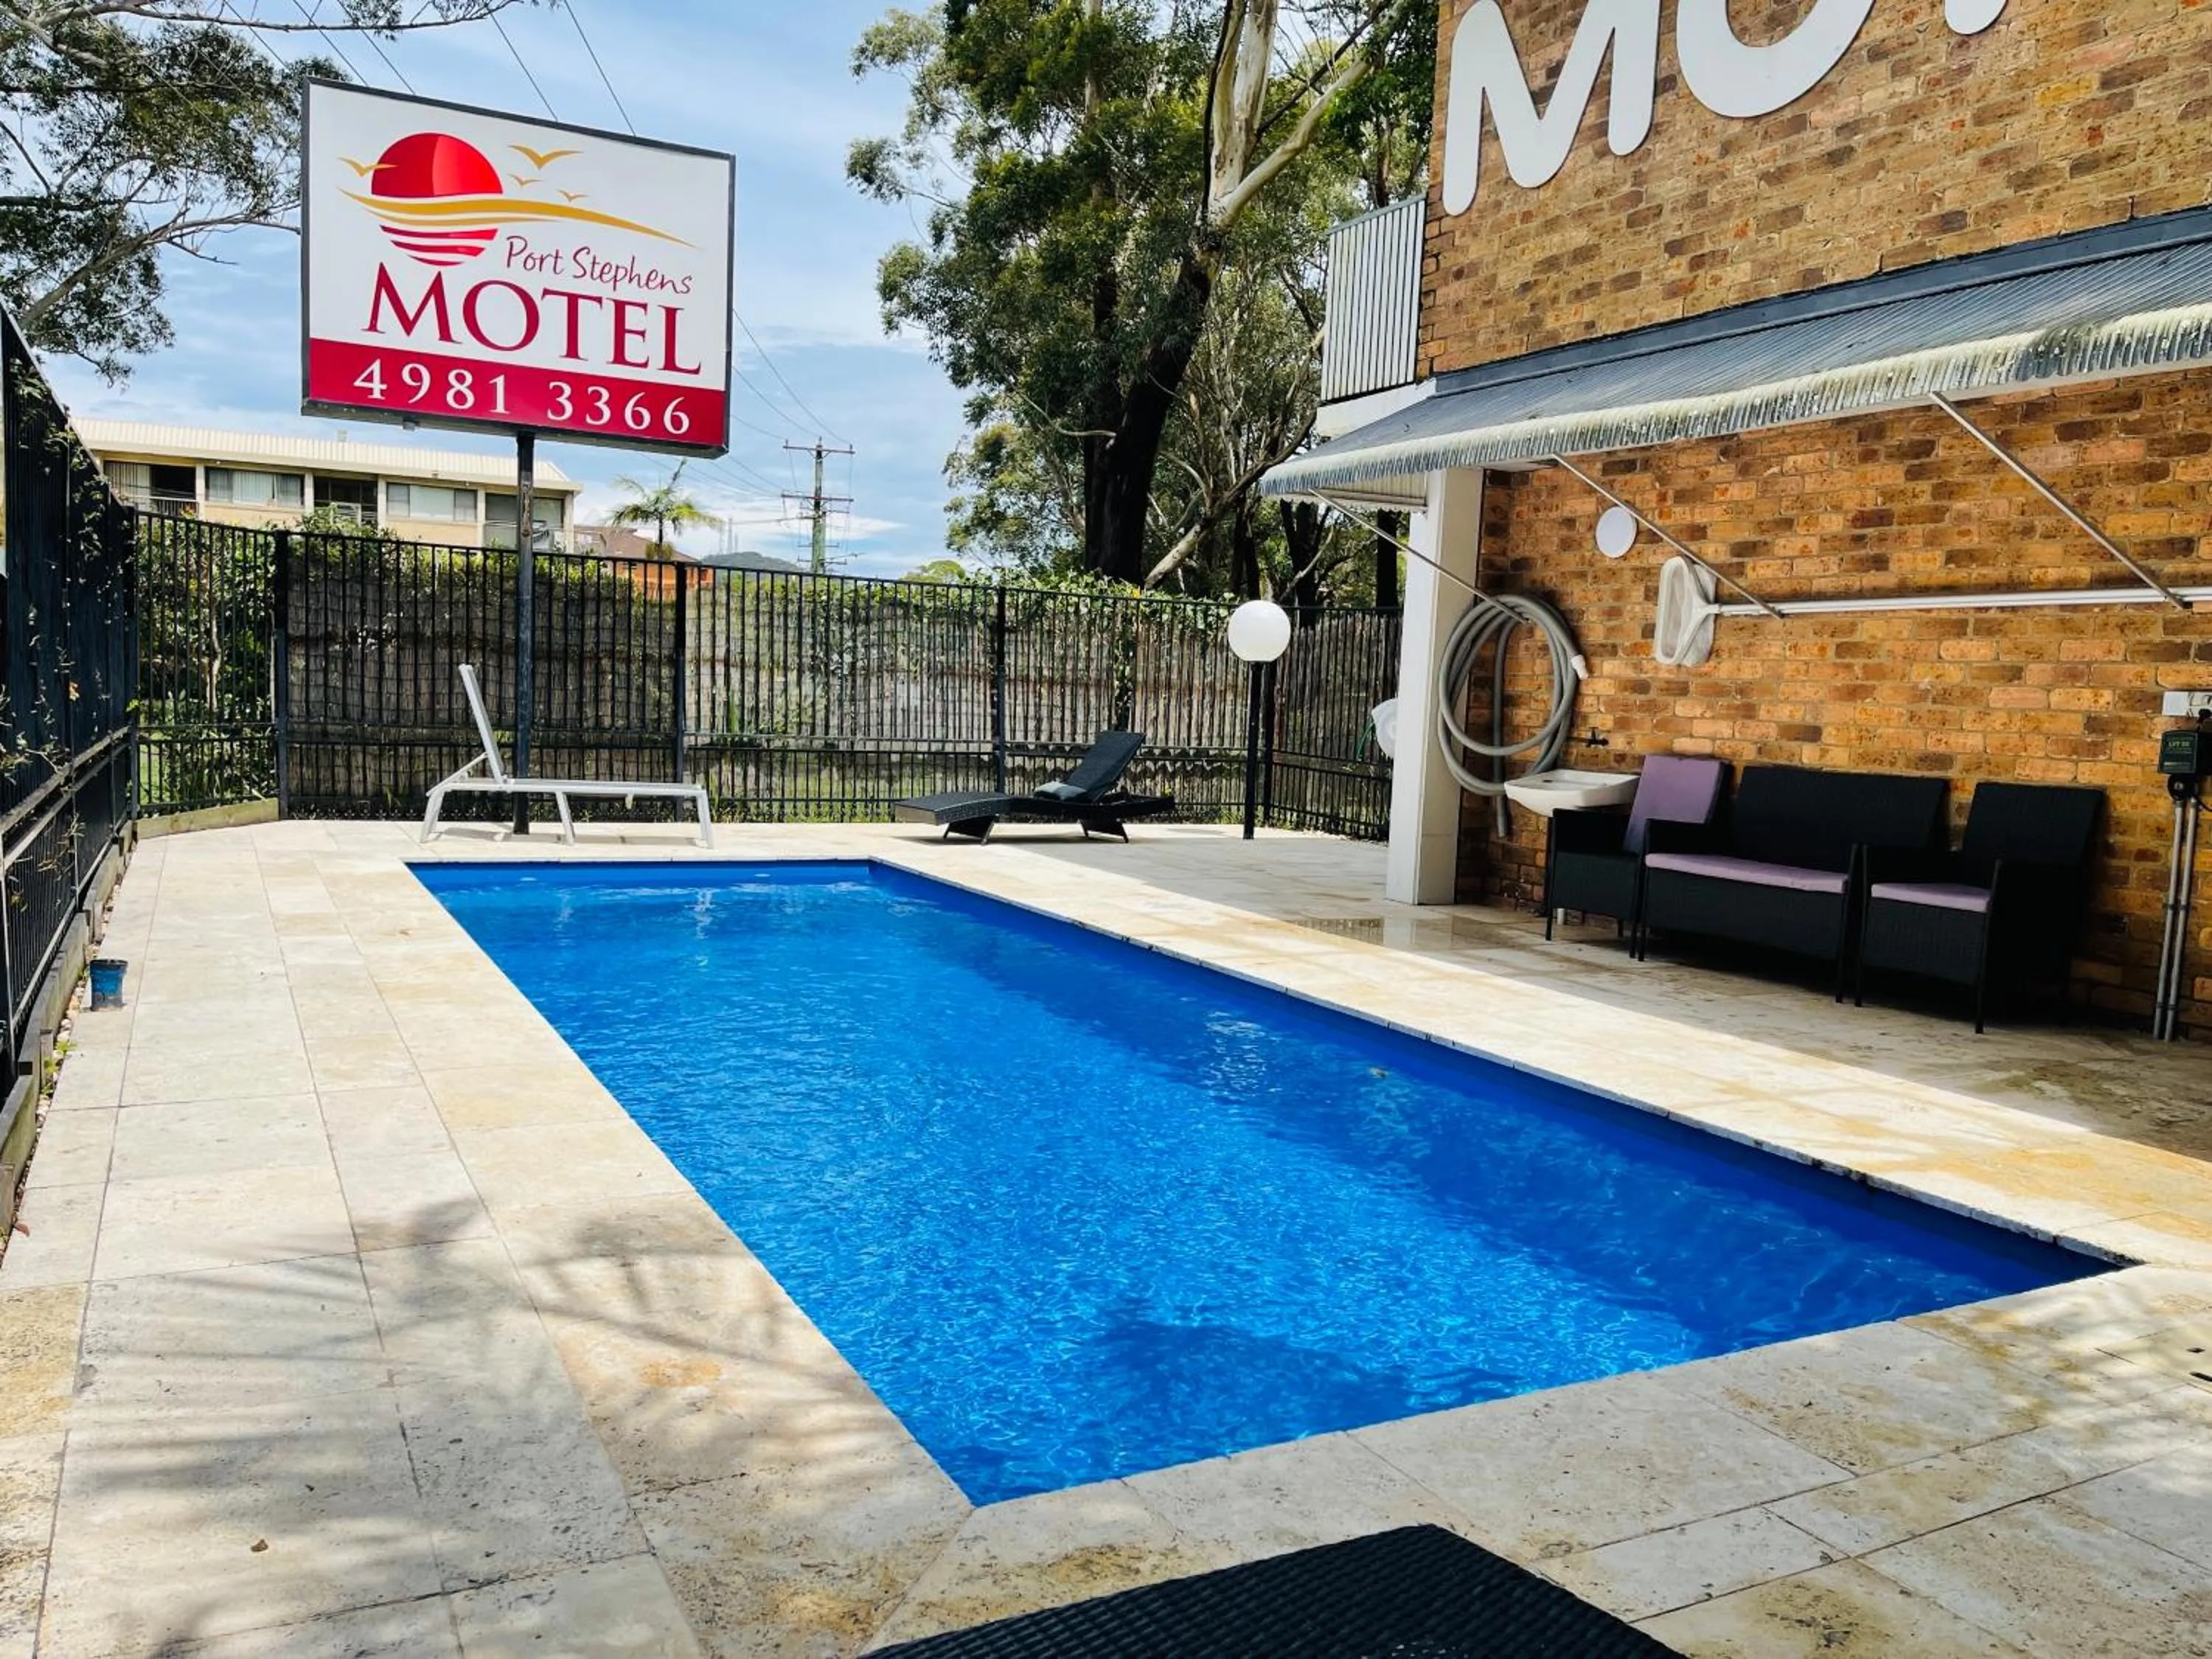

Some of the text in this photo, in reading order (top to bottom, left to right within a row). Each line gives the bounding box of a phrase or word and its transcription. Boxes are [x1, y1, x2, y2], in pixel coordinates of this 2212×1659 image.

[506, 235, 693, 296] Port Stephens
[361, 262, 702, 376] MOTEL
[353, 358, 690, 435] 4981 3366
